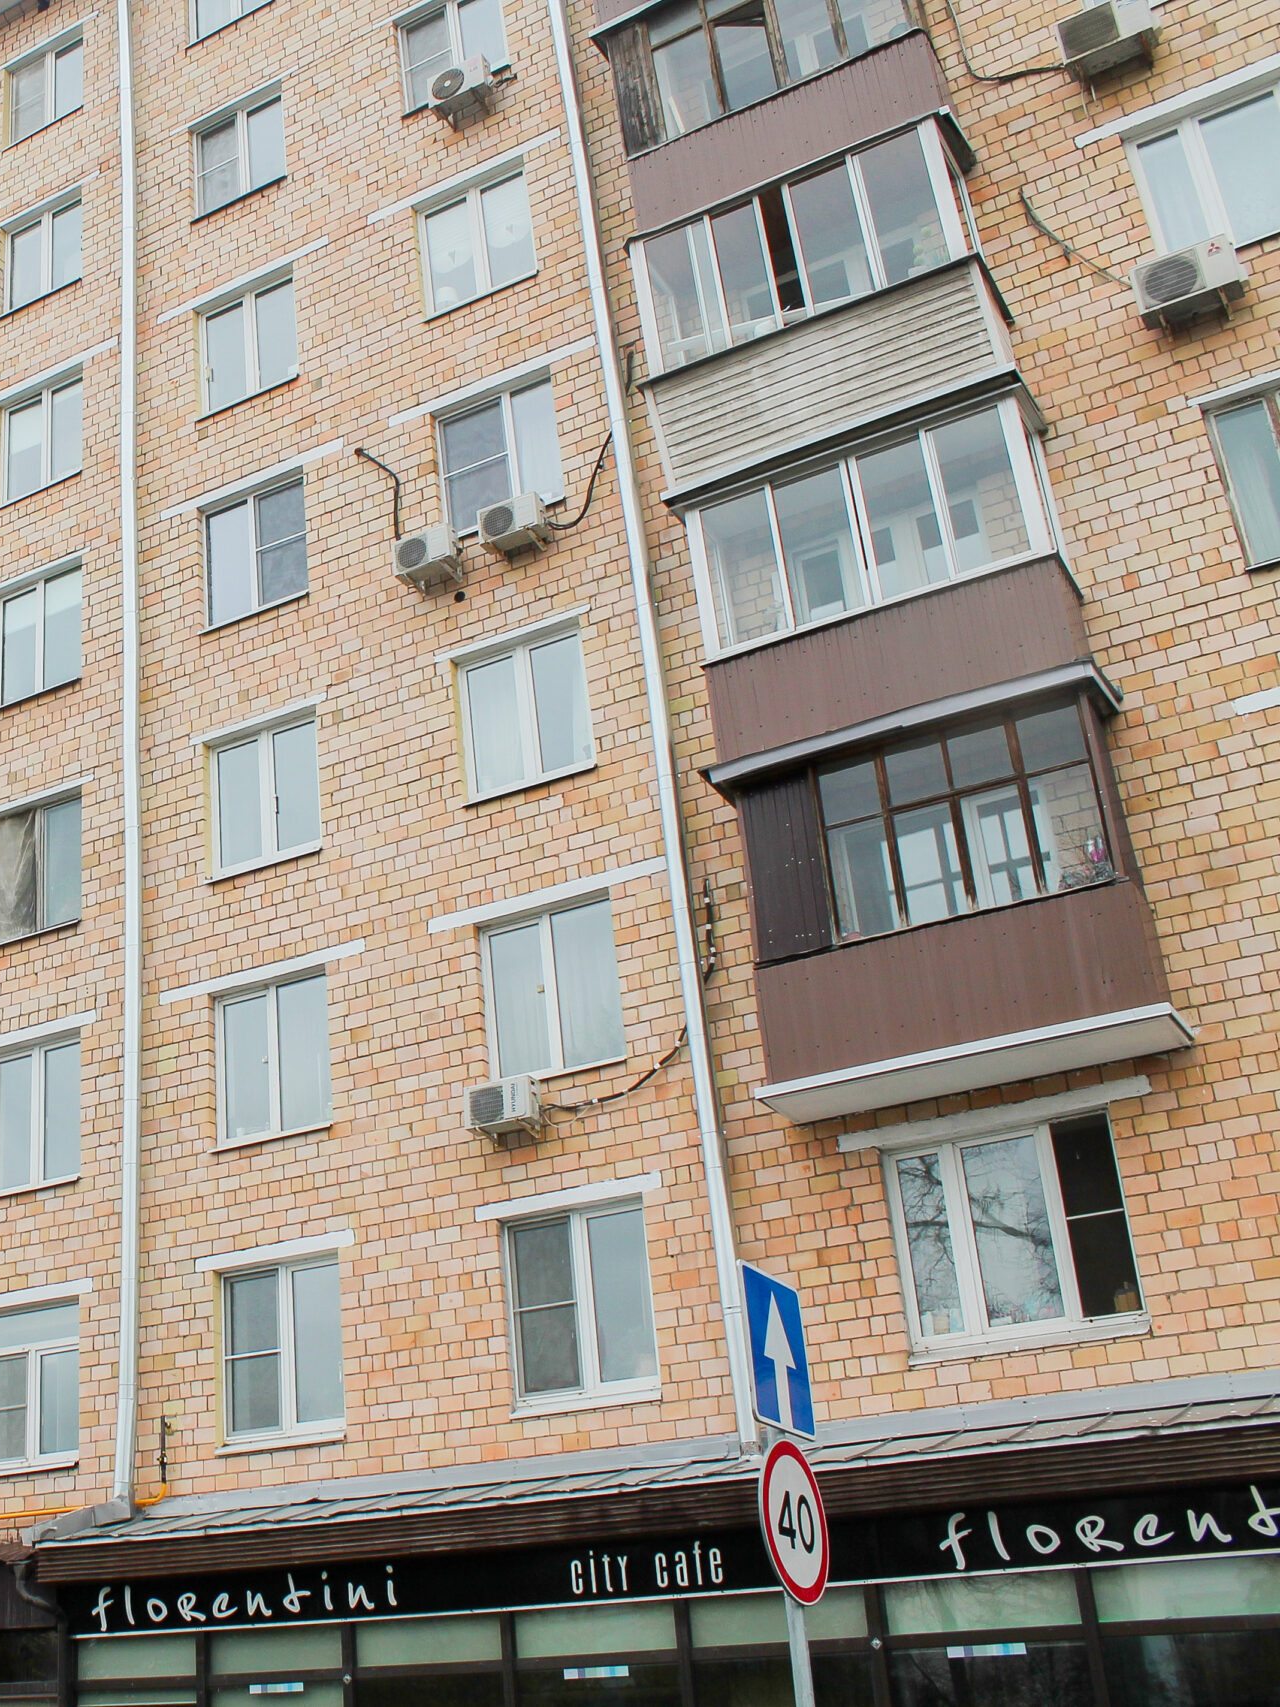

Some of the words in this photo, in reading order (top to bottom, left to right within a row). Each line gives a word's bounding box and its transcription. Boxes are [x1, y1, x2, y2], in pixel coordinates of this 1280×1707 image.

[510, 1083, 518, 1112] HYUNDAI
[778, 1490, 814, 1554] 40
[654, 1541, 723, 1588] cafe
